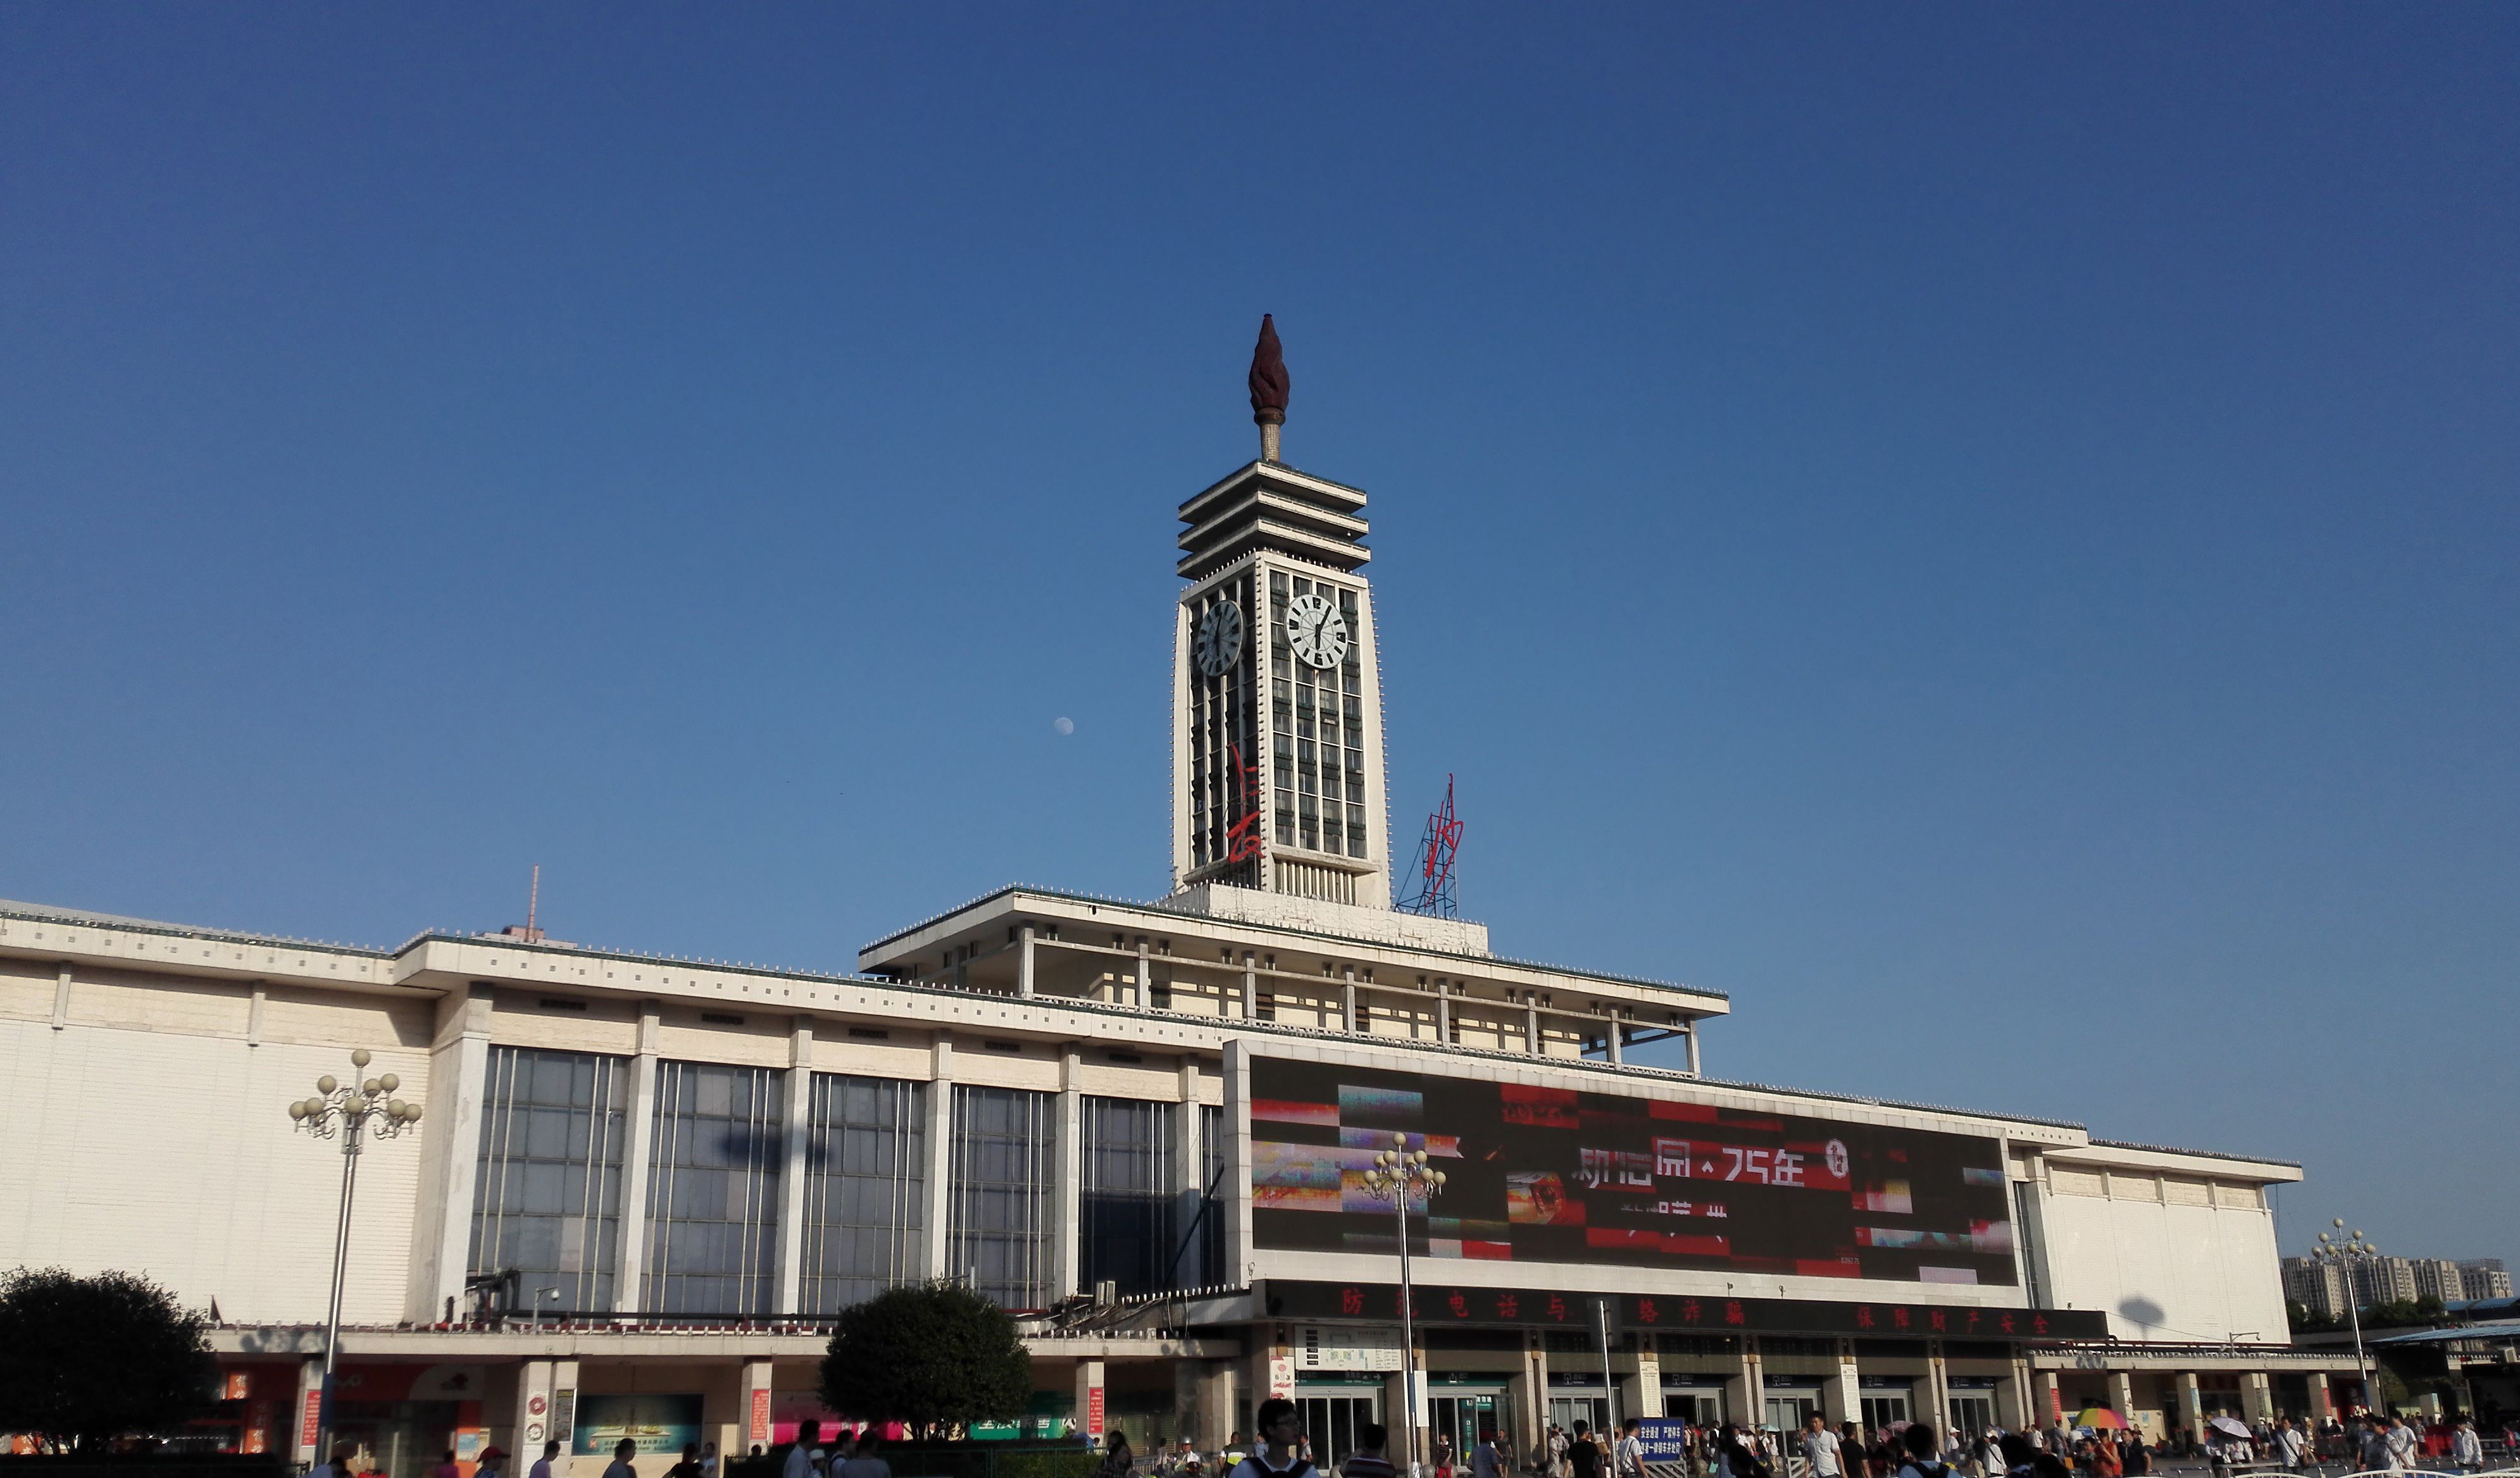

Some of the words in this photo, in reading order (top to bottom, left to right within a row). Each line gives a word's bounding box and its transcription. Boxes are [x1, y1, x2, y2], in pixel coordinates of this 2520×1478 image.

[1641, 1426, 1659, 1438] 安全通道
[1663, 1426, 1681, 1439] 严禁停车
